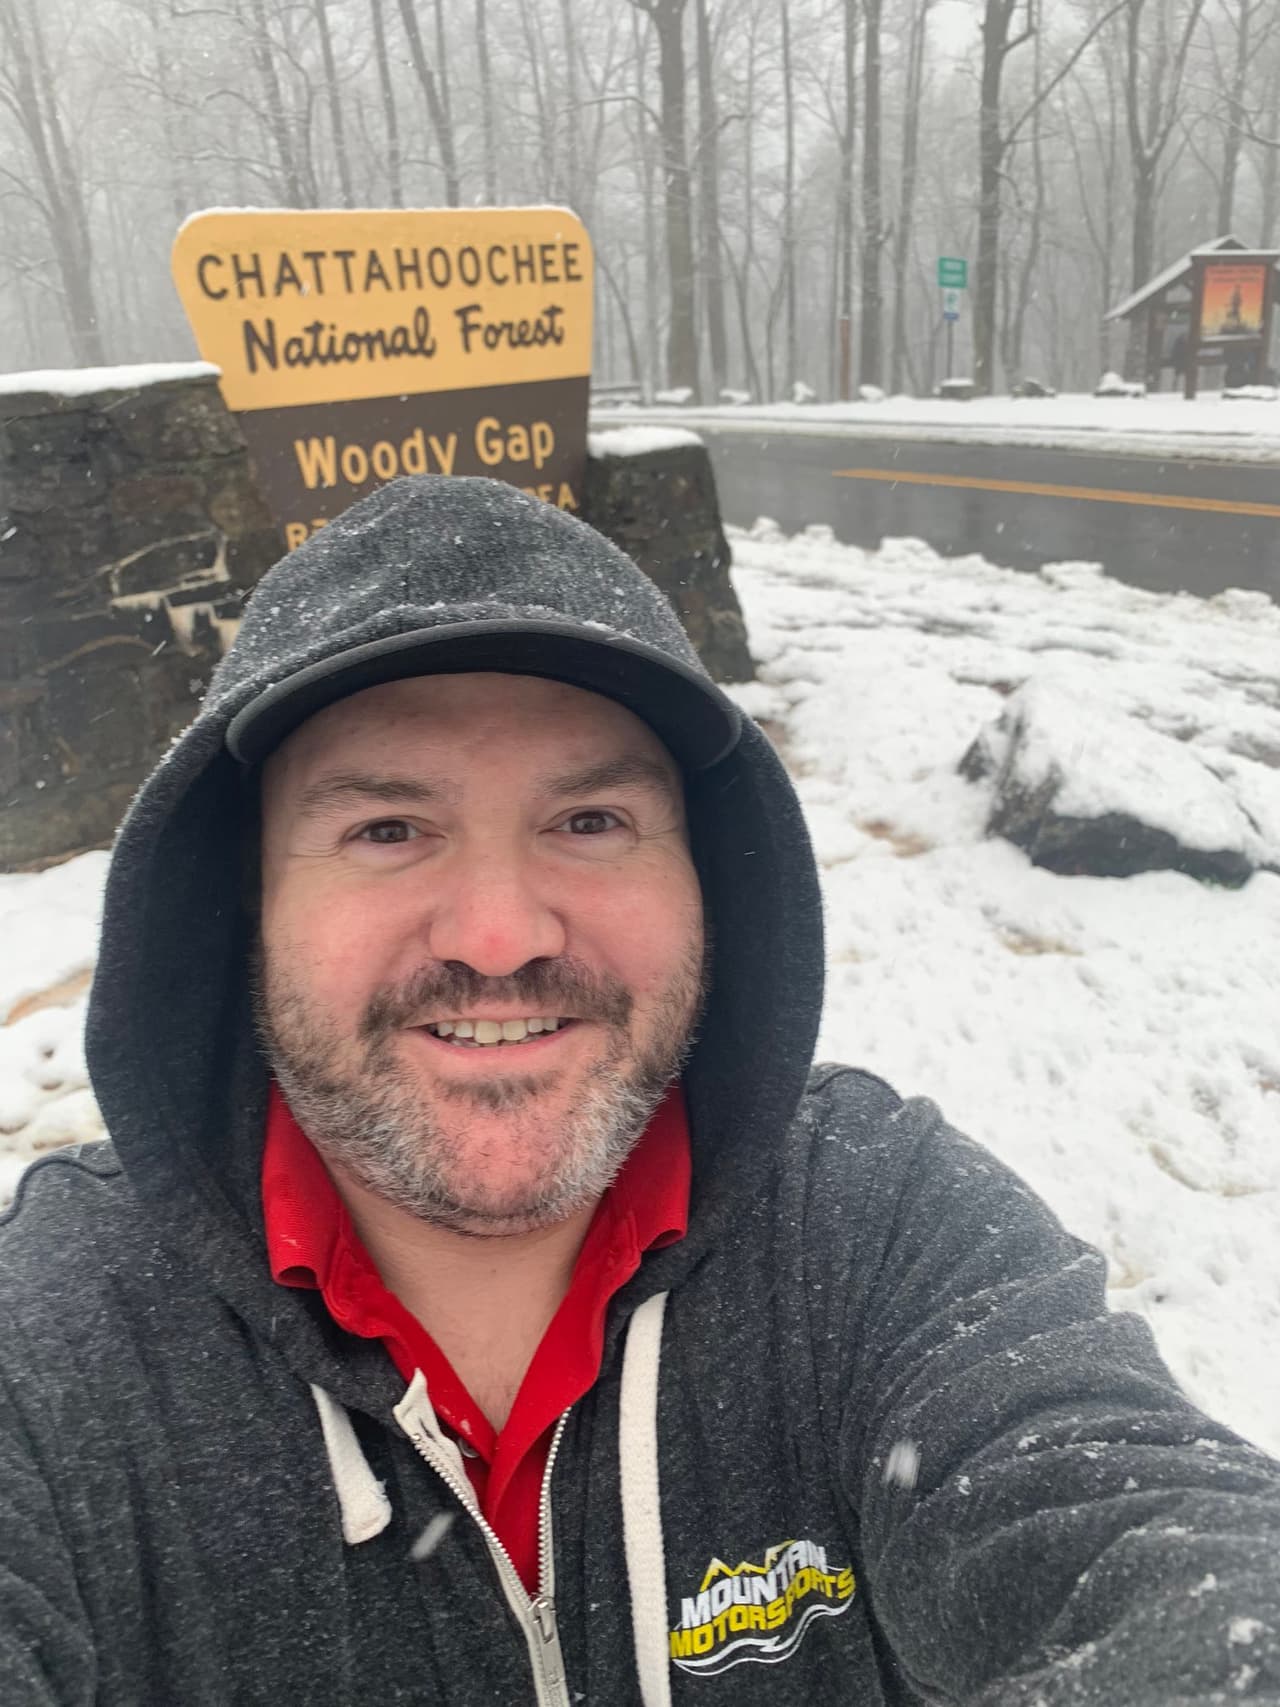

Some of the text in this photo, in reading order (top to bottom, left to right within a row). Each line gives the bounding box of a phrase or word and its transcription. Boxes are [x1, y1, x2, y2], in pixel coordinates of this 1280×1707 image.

[196, 242, 583, 300] CHATTAHOOCHEE
[242, 303, 565, 374] National Forest
[294, 416, 556, 490] Woody Gap
[669, 1564, 856, 1659] MOTORSPORTS
[681, 1540, 828, 1630] MOUNTAIN
